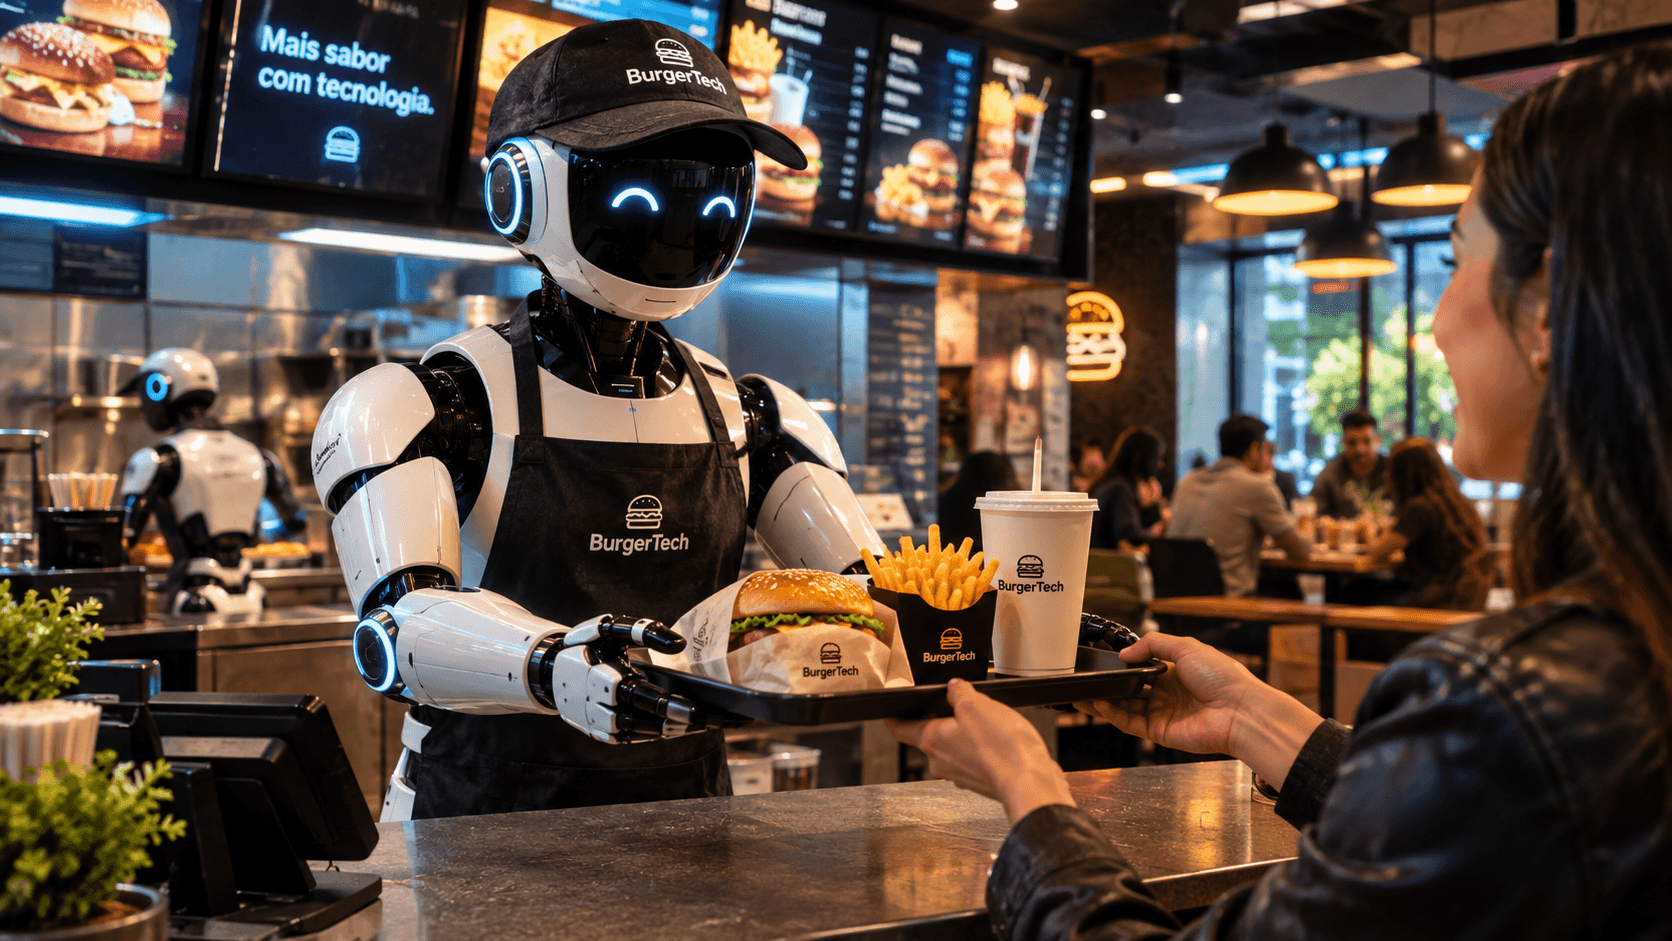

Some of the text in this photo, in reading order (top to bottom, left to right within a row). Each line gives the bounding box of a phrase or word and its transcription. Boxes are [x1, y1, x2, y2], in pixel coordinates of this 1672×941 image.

[259, 25, 391, 73] Mais sabor
[258, 67, 435, 117] com tecnologia.
[626, 68, 728, 95] BurgerTech
[589, 533, 689, 556] BurgerTech
[998, 580, 1064, 595] BurgerTech
[923, 650, 976, 664] BurgerTech
[802, 665, 859, 679] BurgerTech
